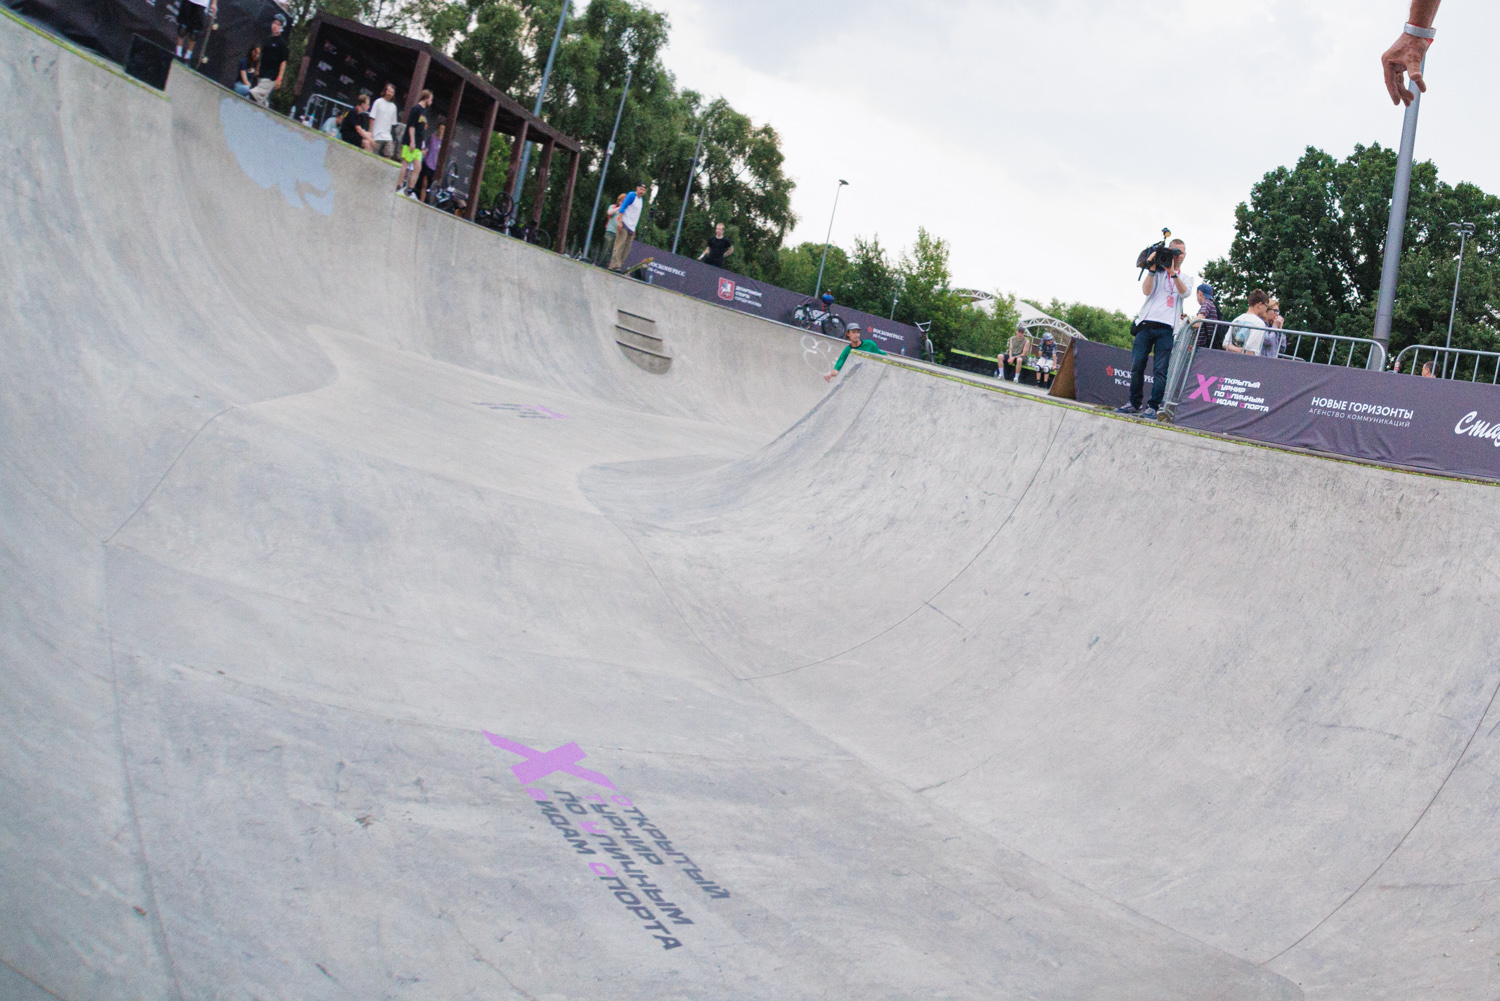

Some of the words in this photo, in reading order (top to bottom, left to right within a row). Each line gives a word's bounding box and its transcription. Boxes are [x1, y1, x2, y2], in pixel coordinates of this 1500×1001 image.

[1217, 384, 1246, 393] ТУРНИР
[1219, 377, 1261, 388] ОТКРЫТЫЙ
[1212, 397, 1239, 407] ВИДАМ
[1239, 402, 1269, 412] СПОРТА
[1226, 392, 1265, 404] УЛИЧНЫМ
[1311, 396, 1348, 410] НОВЫЕ
[1348, 402, 1414, 419] ГОРИЗОНТЫ
[1308, 408, 1346, 419] АГЕНСТВО
[1347, 413, 1411, 428] КОММУНИКАЦИЙ
[584, 792, 664, 866] ТУРНИР
[553, 789, 588, 816] ПО
[578, 821, 695, 925] УЛИЧНЫМ
[610, 794, 731, 900] ОТКРЫТЫЙ
[524, 787, 597, 855] ВИДАМ
[588, 862, 683, 951] СПОРТА
